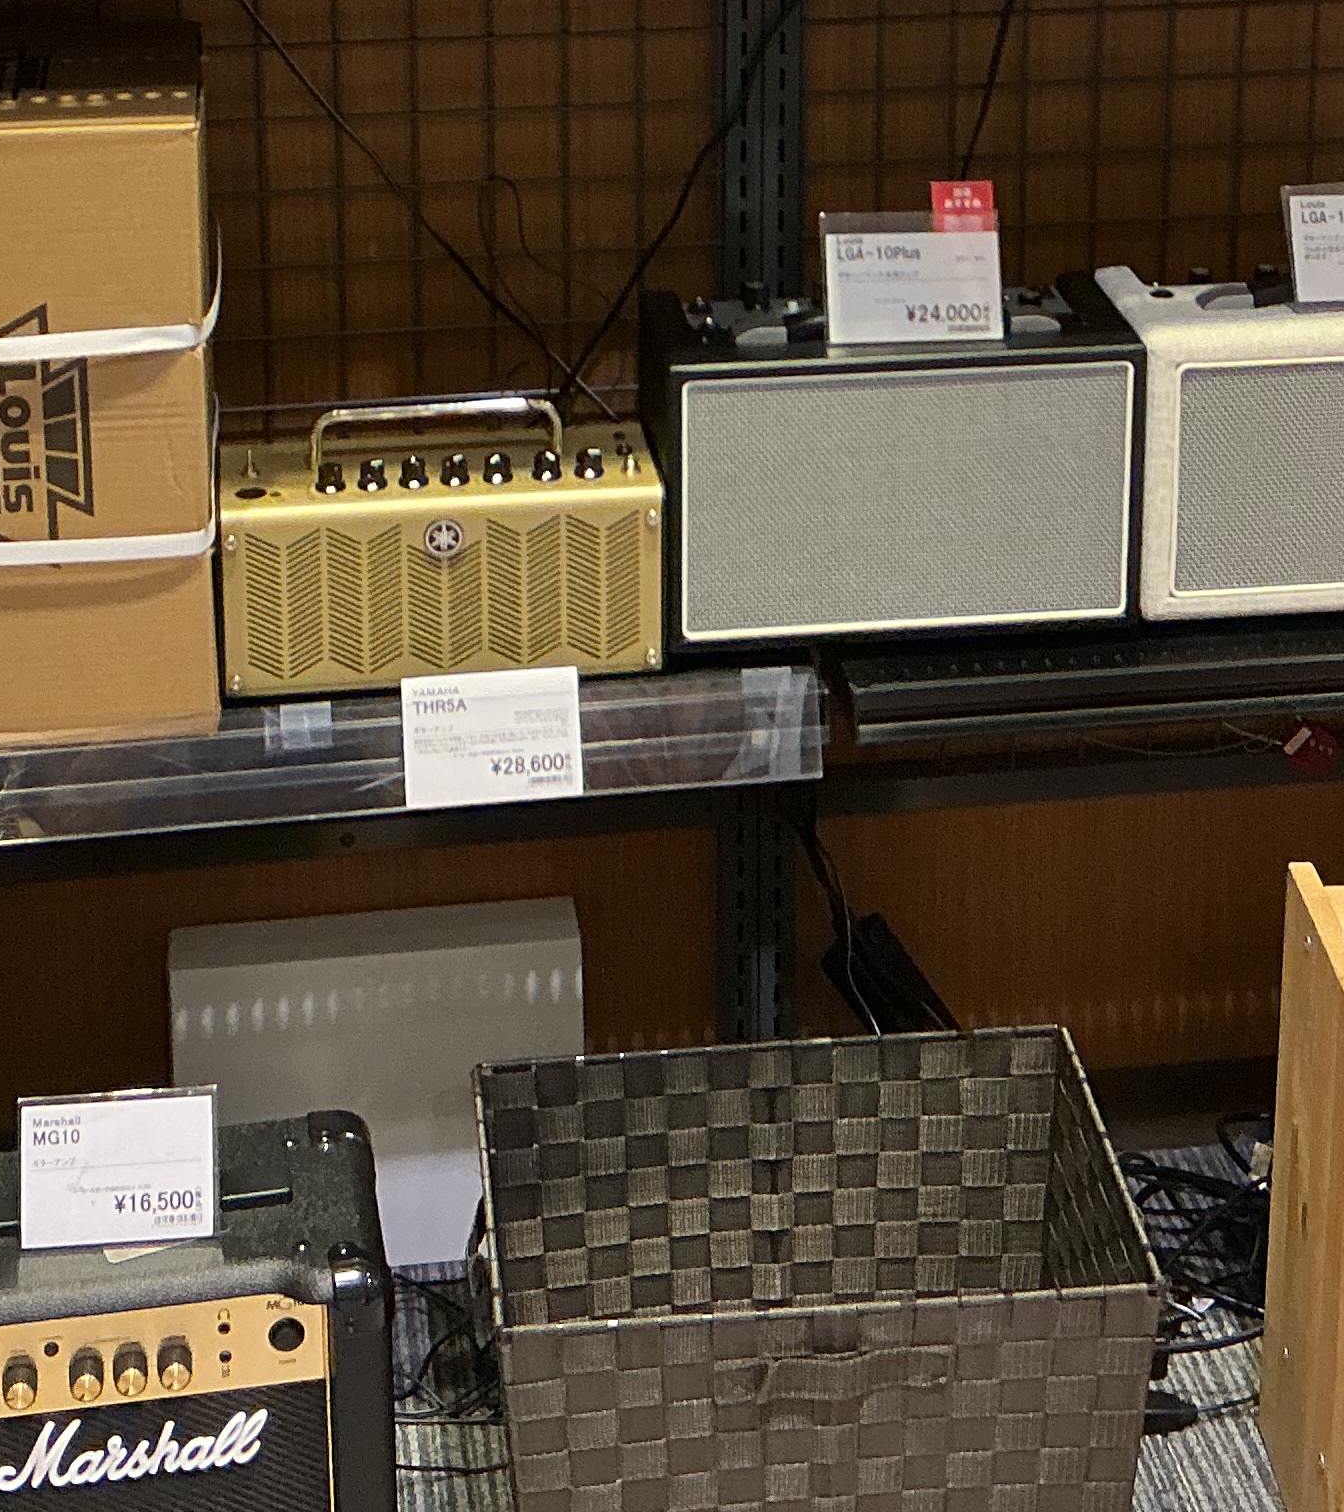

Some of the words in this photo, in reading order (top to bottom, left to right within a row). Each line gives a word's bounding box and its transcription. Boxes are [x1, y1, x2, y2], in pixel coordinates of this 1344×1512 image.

[837, 247, 921, 261] LGA-10Plus
[906, 302, 984, 323] ¥24,000
[412, 687, 459, 697] YAMAHA
[414, 699, 467, 715] THR5A
[491, 754, 564, 776] ¥28,600
[33, 1116, 80, 1127] Marshall
[32, 1130, 80, 1146] MG10
[114, 1191, 194, 1214] ¥16,500
